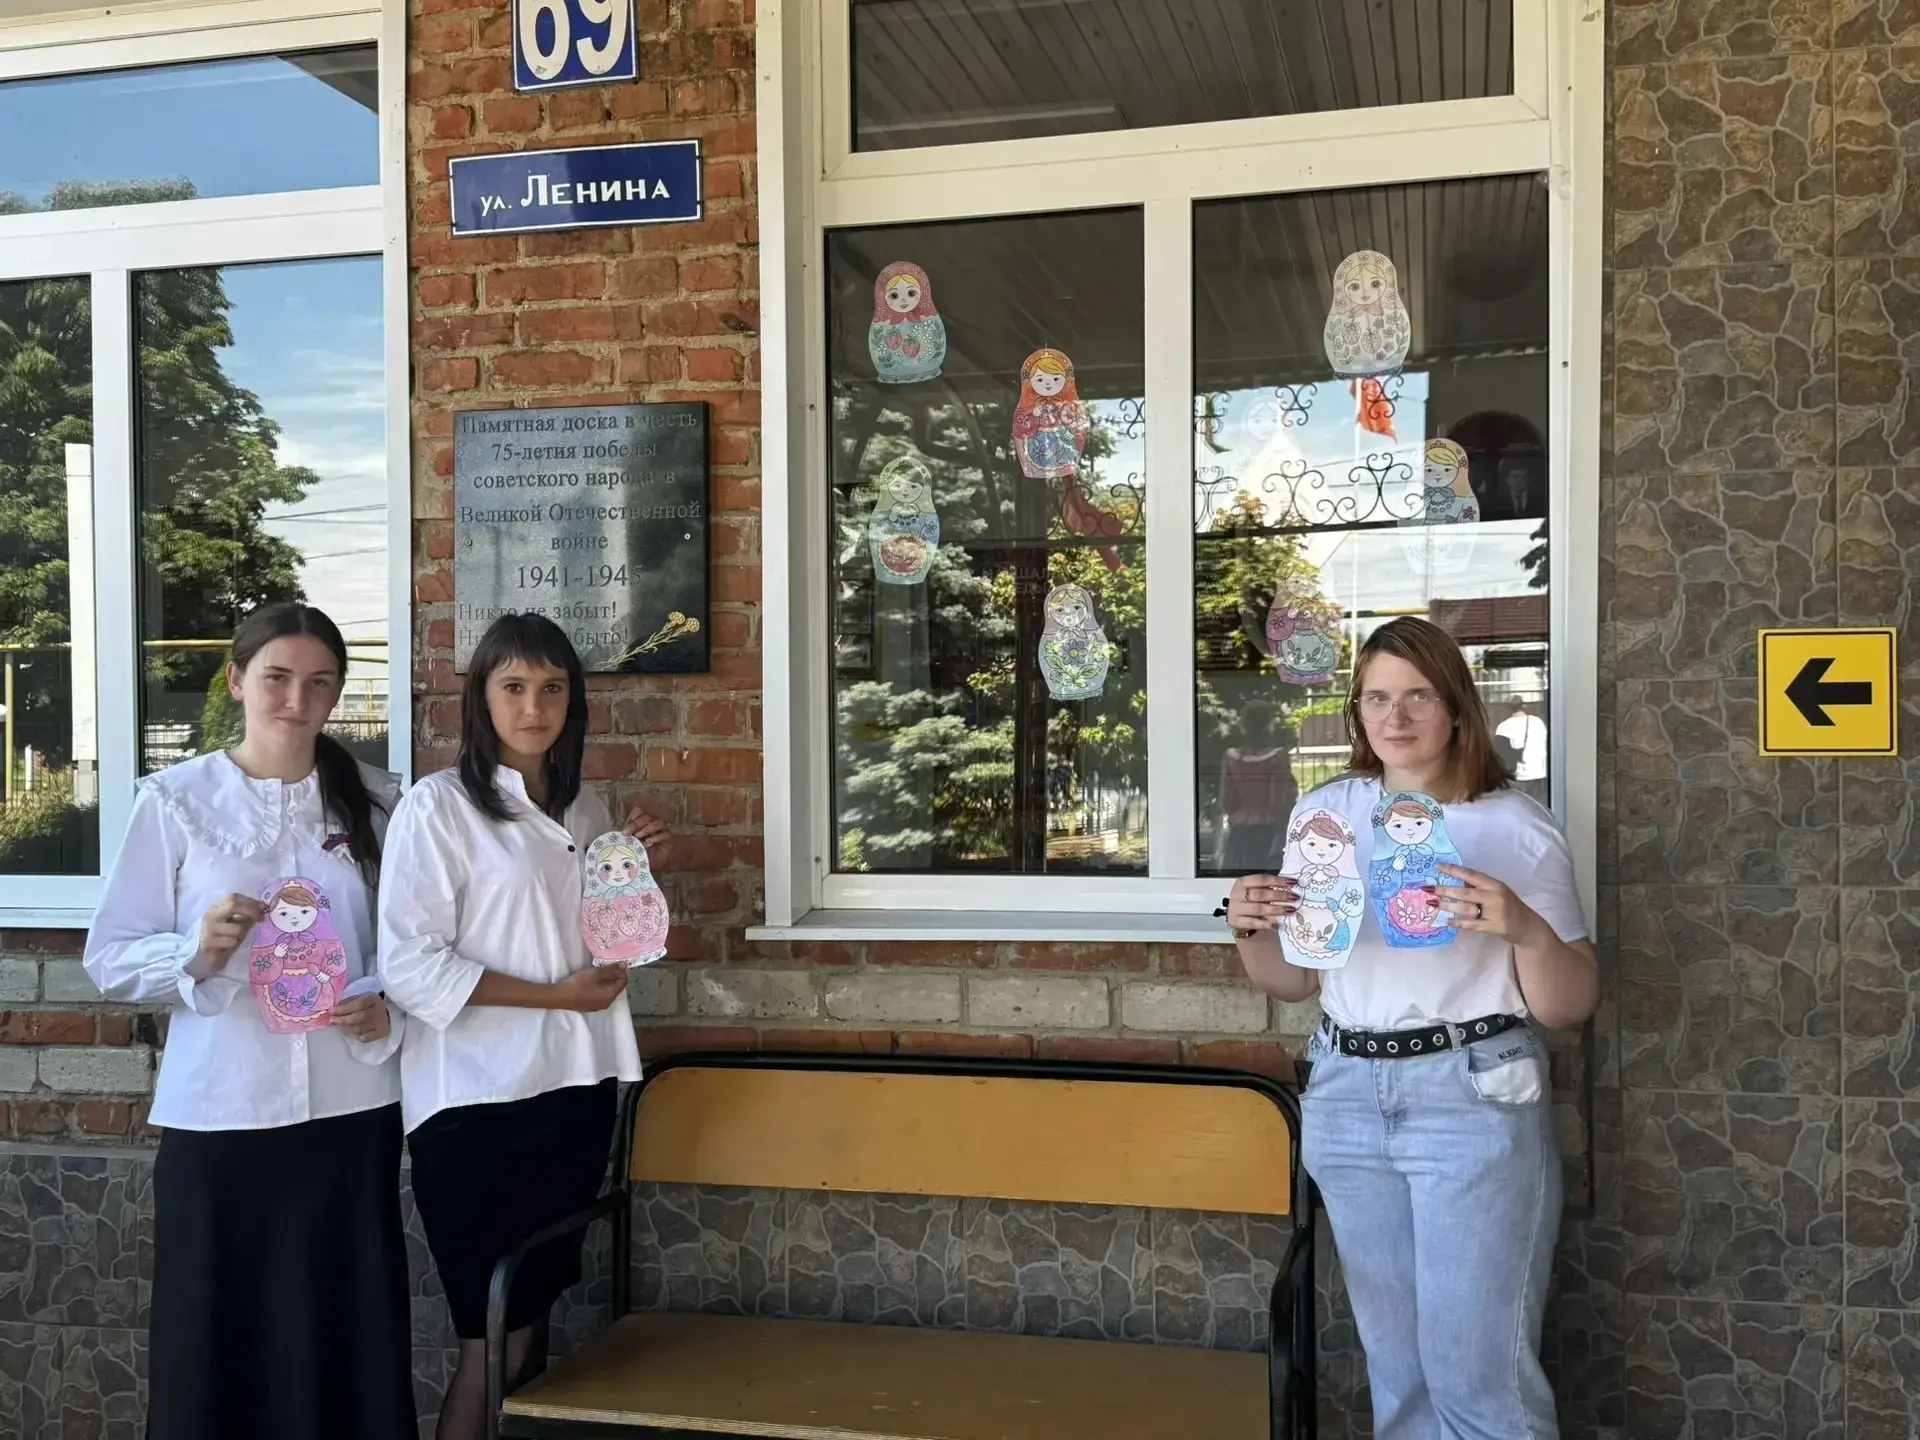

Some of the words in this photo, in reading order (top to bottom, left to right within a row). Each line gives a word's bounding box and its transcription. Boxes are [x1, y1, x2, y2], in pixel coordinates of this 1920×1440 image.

[519, 0, 628, 80] 69
[480, 195, 513, 217] ул.
[463, 416, 556, 434] Памятная
[562, 414, 617, 432] доска
[625, 417, 635, 429] в
[641, 413, 697, 428] честь
[491, 443, 575, 461] 75-летия
[583, 440, 657, 459] победы
[474, 474, 578, 489] советского
[585, 473, 654, 491] народа
[664, 473, 675, 484] в
[460, 504, 543, 523] Великой
[549, 500, 700, 522] Отечественной
[551, 532, 608, 550] войне
[517, 564, 643, 588] 1941-1945
[459, 603, 516, 620] Никто
[552, 601, 616, 619] забыт!
